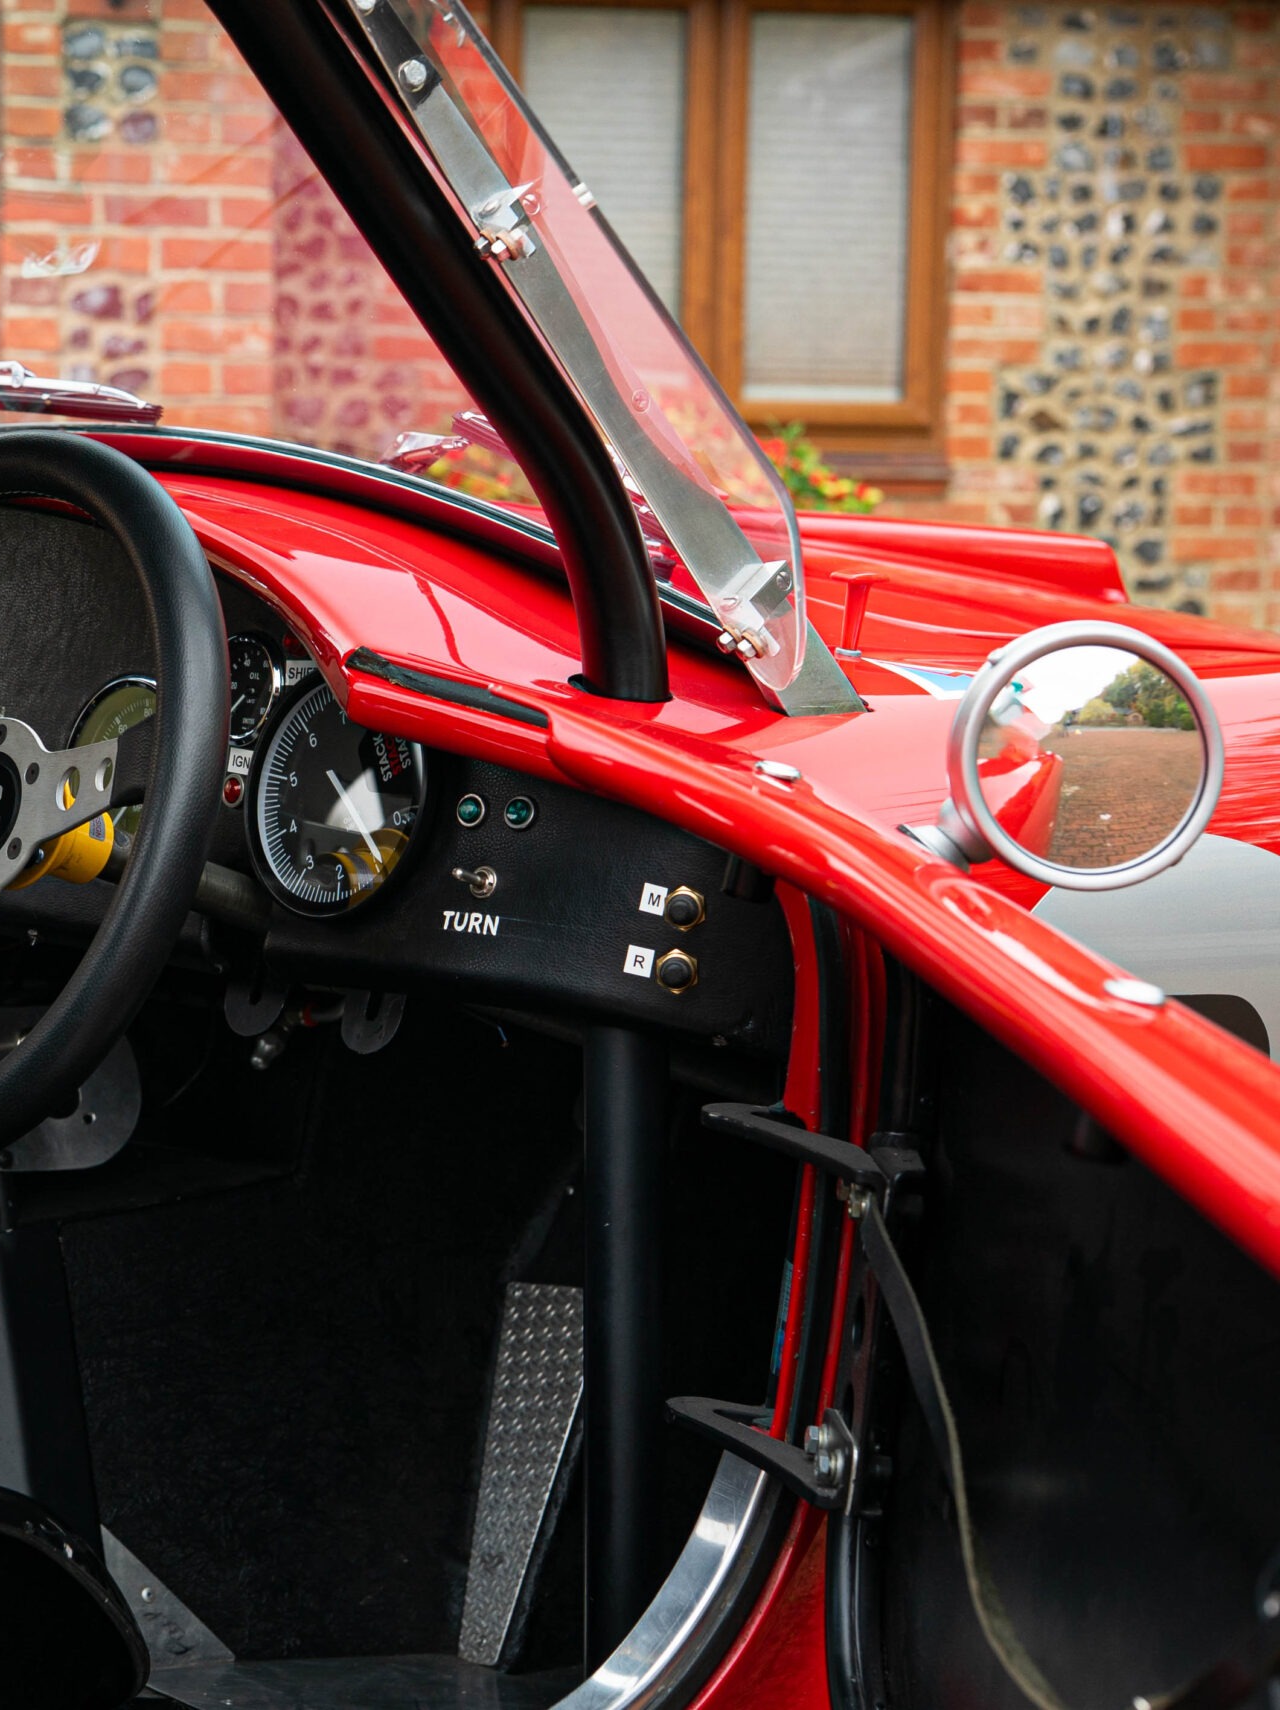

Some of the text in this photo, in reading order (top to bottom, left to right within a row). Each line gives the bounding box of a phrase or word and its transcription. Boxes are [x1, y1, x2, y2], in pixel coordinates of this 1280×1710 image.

[249, 672, 260, 680] OIL
[309, 733, 318, 748] 6
[232, 754, 250, 769] IGN
[372, 733, 393, 782] STACK
[289, 771, 298, 787] 5
[289, 820, 298, 833] 4
[306, 855, 315, 870] 3
[335, 864, 345, 880] 2
[647, 892, 661, 908] M
[442, 910, 500, 936] TURN
[633, 954, 645, 969] R
